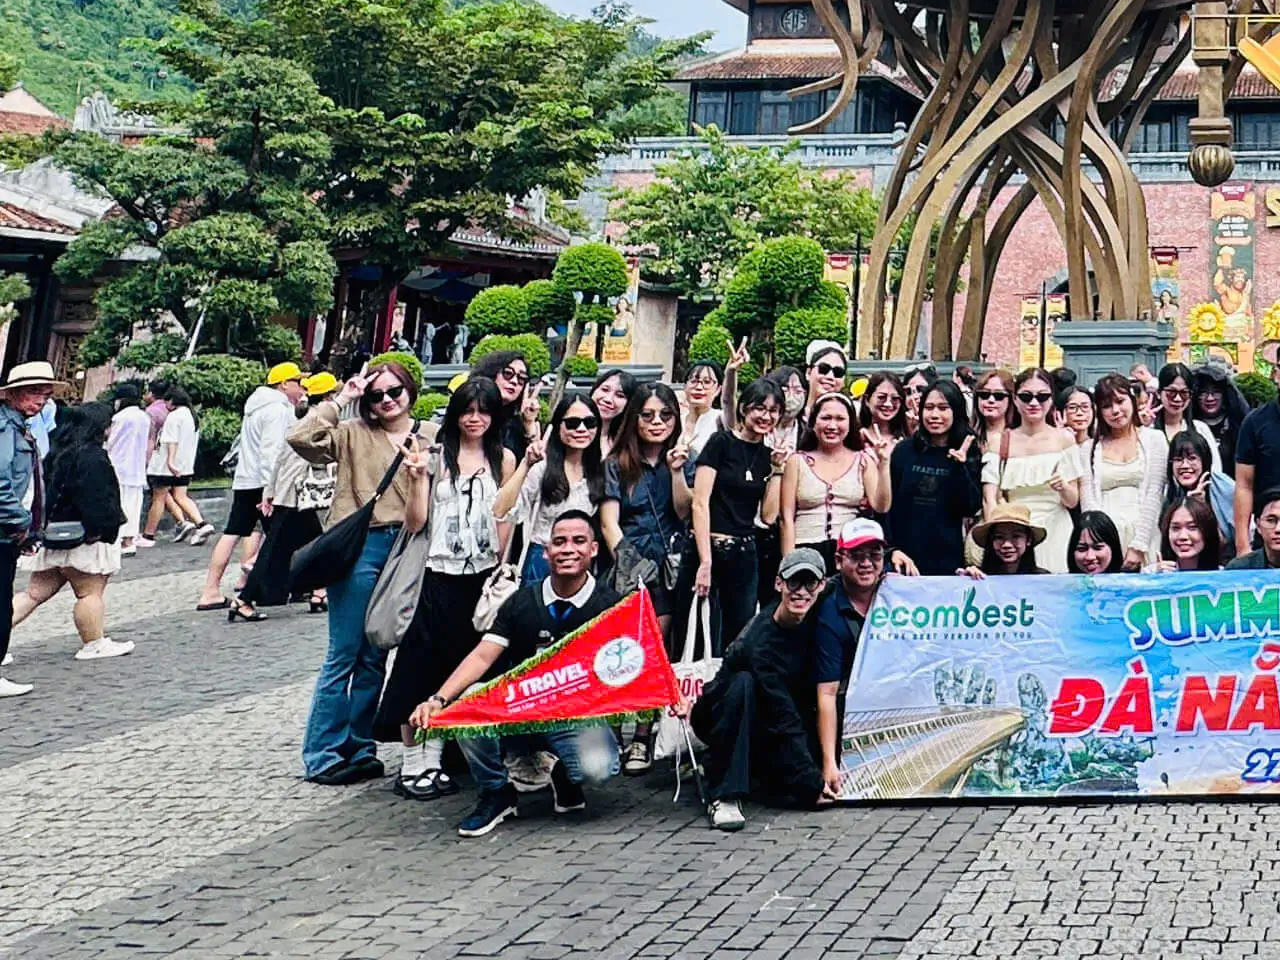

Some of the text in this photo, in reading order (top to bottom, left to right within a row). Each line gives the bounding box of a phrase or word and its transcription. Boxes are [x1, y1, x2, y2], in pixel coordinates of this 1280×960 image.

[870, 586, 1034, 628] ecombest
[504, 683, 516, 702] J
[519, 662, 589, 697] TRAVEL
[1048, 658, 1155, 735] ĐÀ
